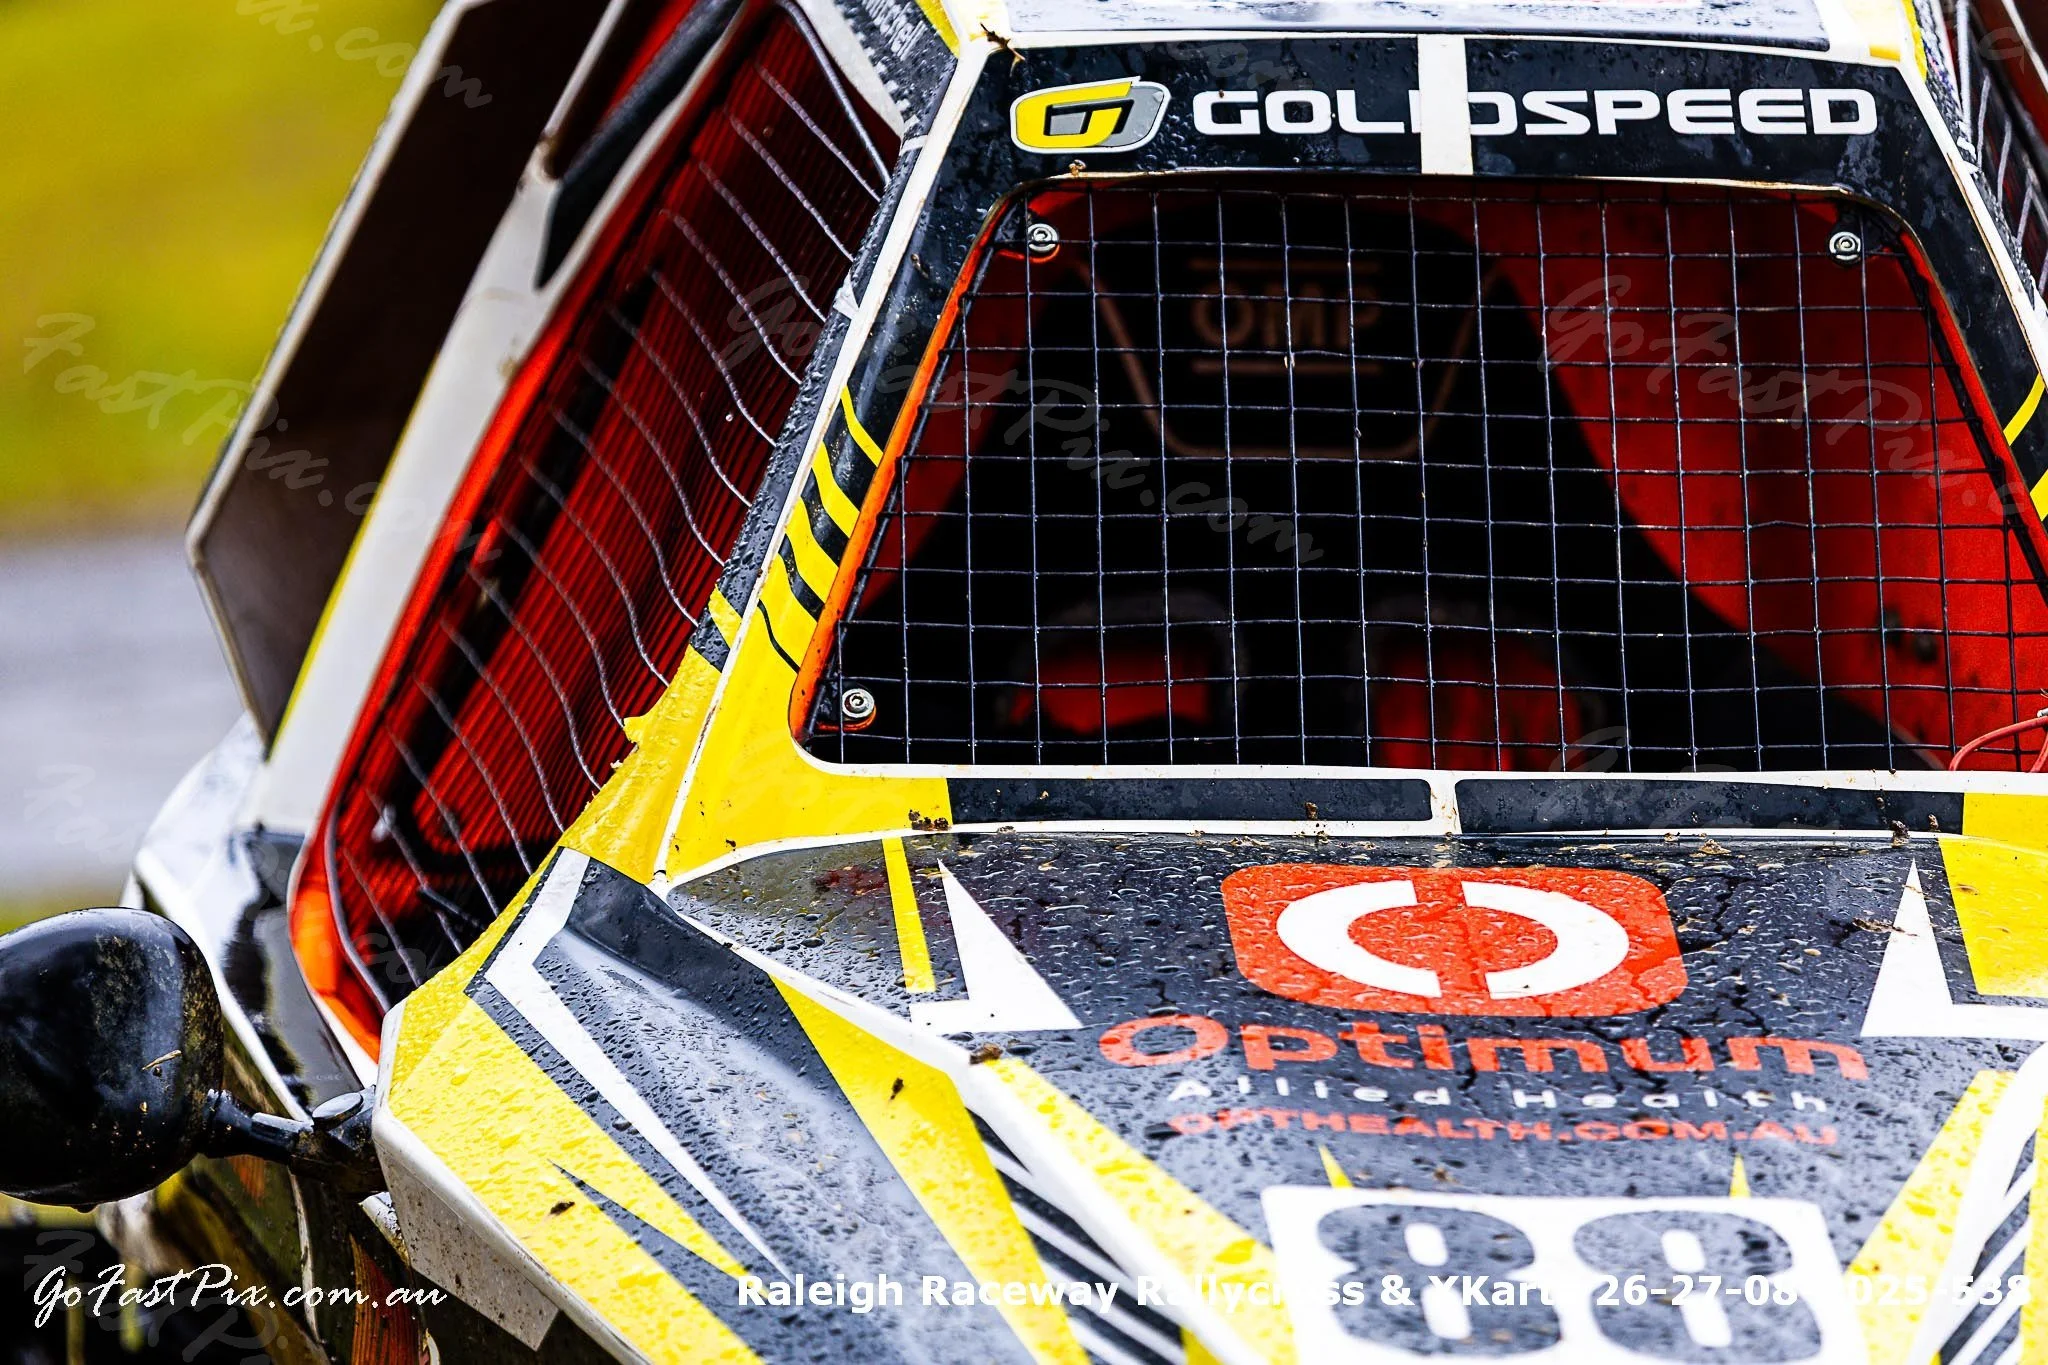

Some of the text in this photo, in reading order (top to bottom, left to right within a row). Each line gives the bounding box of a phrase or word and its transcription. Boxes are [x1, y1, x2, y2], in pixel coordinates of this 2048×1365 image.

[1190, 282, 1382, 349] OMP
[1099, 1014, 1868, 1081] Optimum
[1168, 1074, 1828, 1113] Allied Health
[1168, 1107, 1838, 1146] OPTHEALTH.COM.AU
[1317, 1203, 1824, 1364] 88
